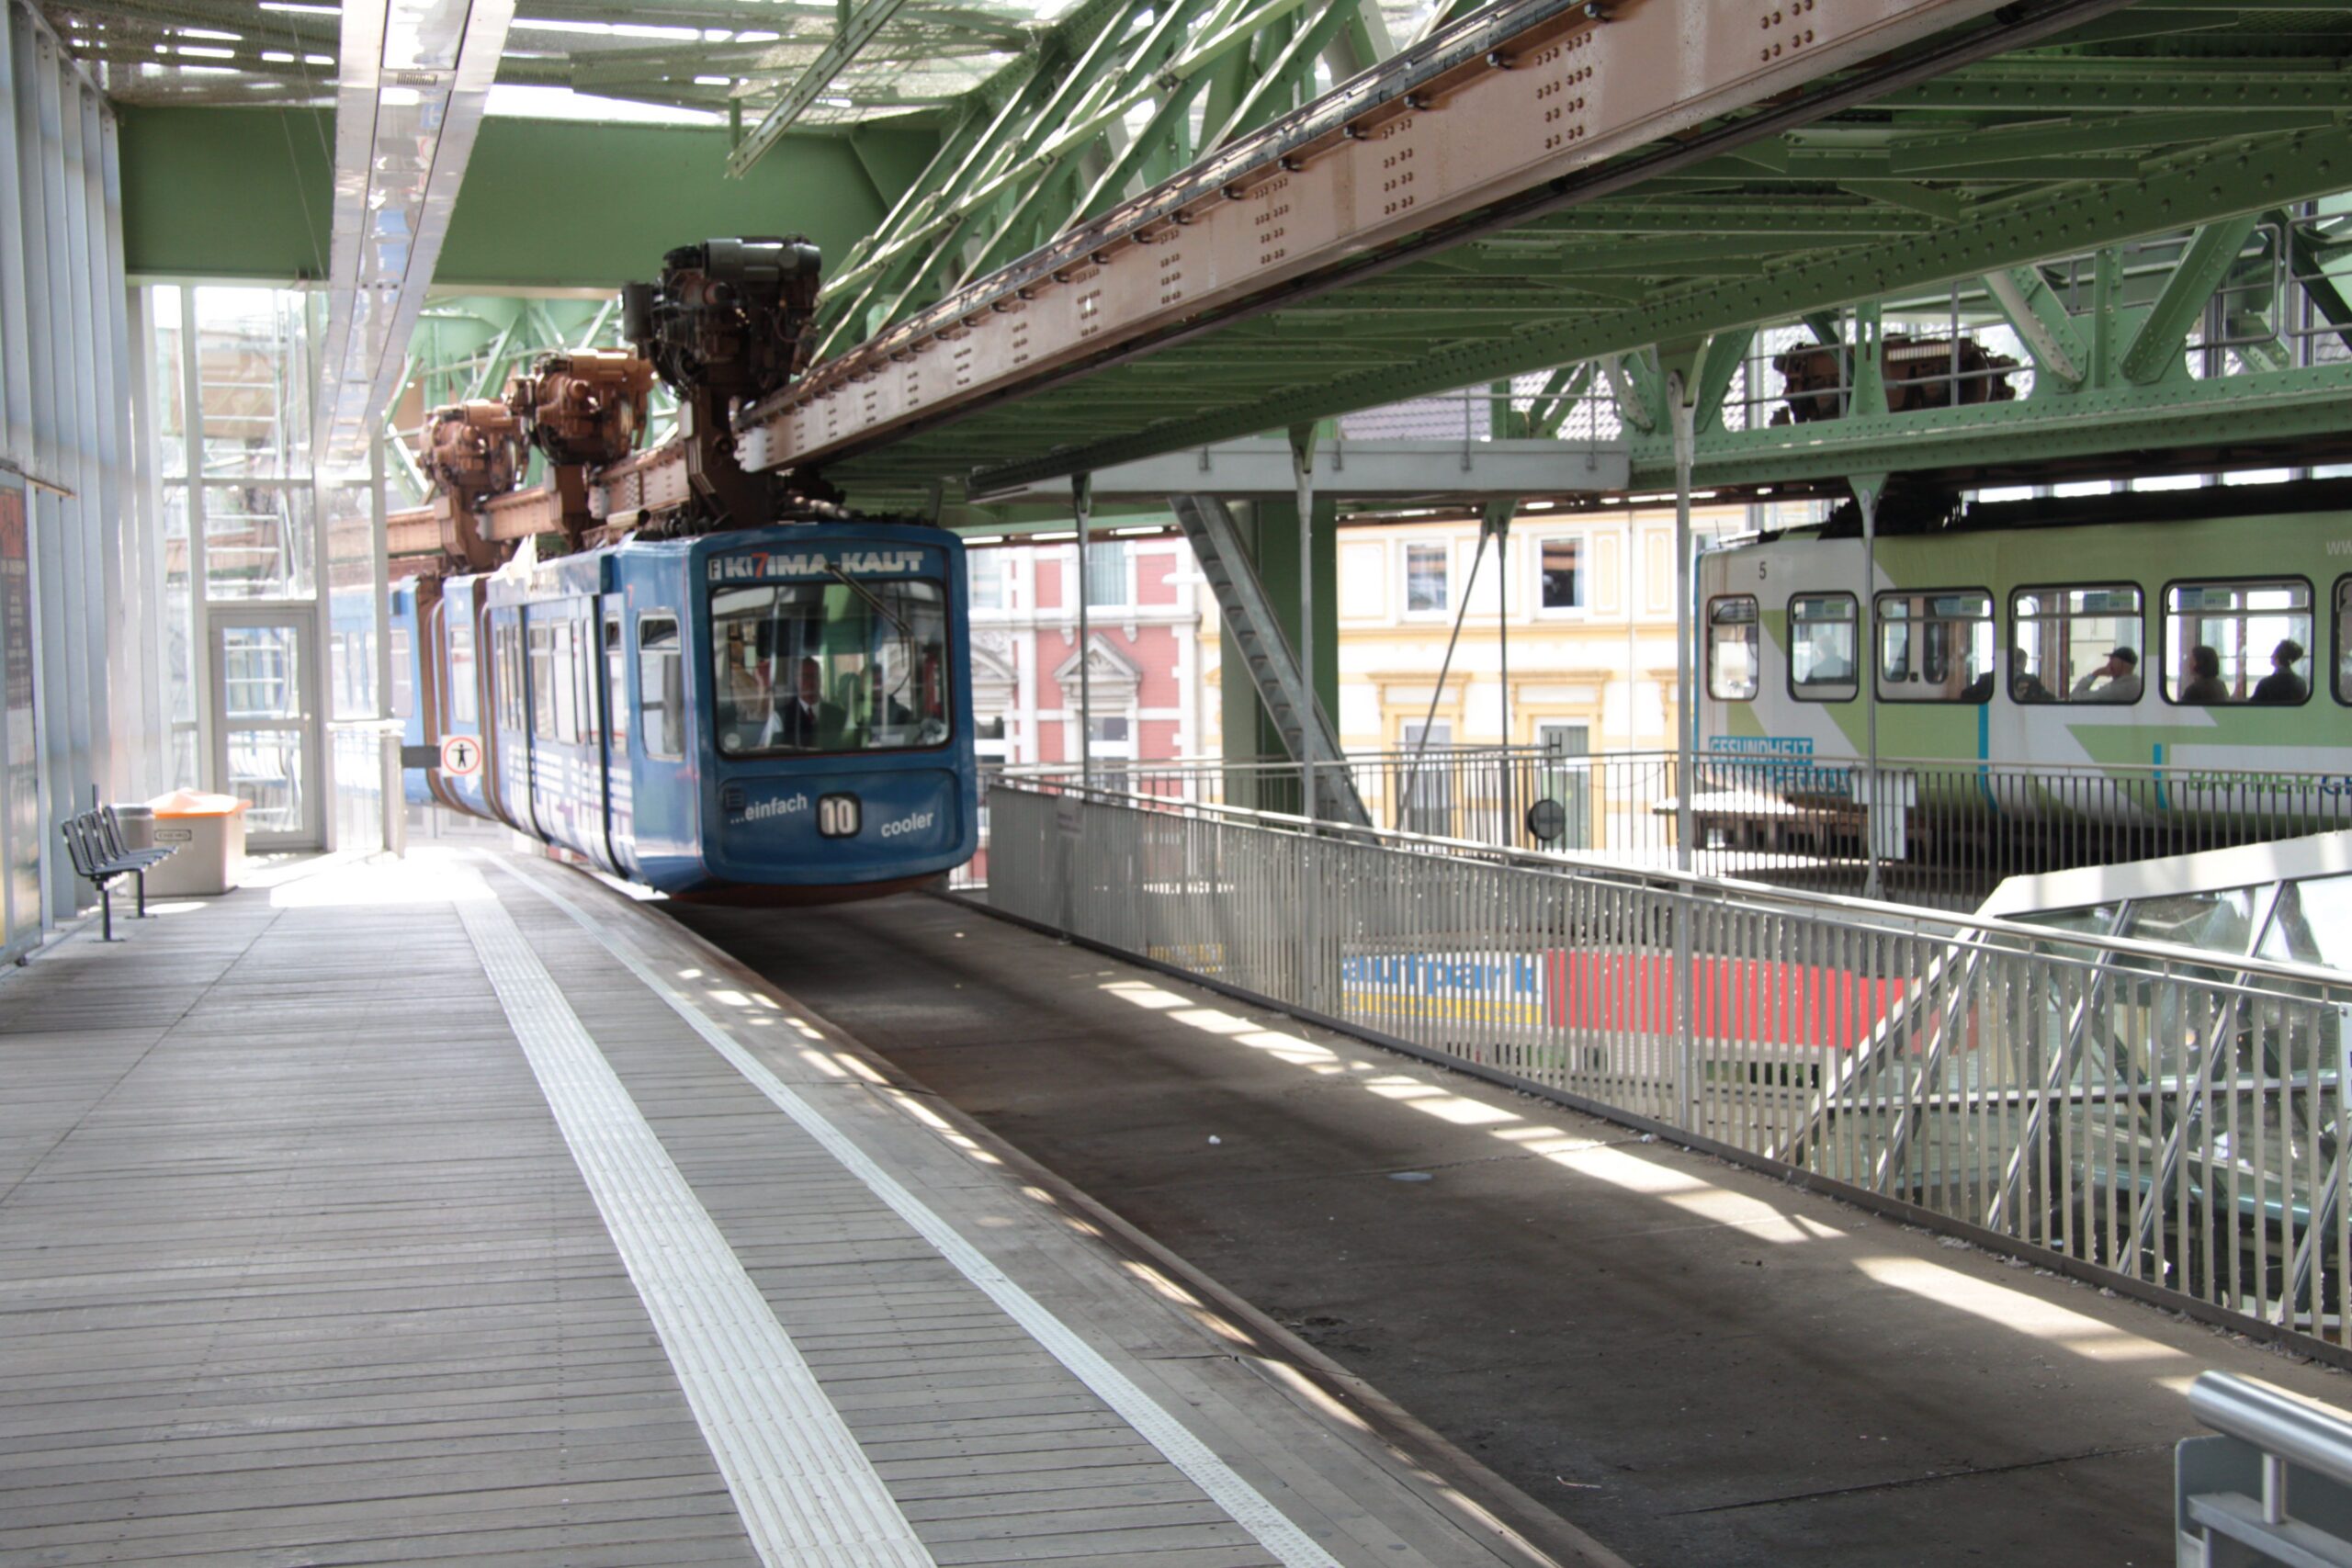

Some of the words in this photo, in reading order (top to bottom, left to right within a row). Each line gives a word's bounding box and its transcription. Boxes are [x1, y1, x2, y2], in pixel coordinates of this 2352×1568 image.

[1759, 560, 1767, 581] 5
[1710, 738, 1811, 763] GESUNDHEIT
[881, 813, 934, 838] cooler
